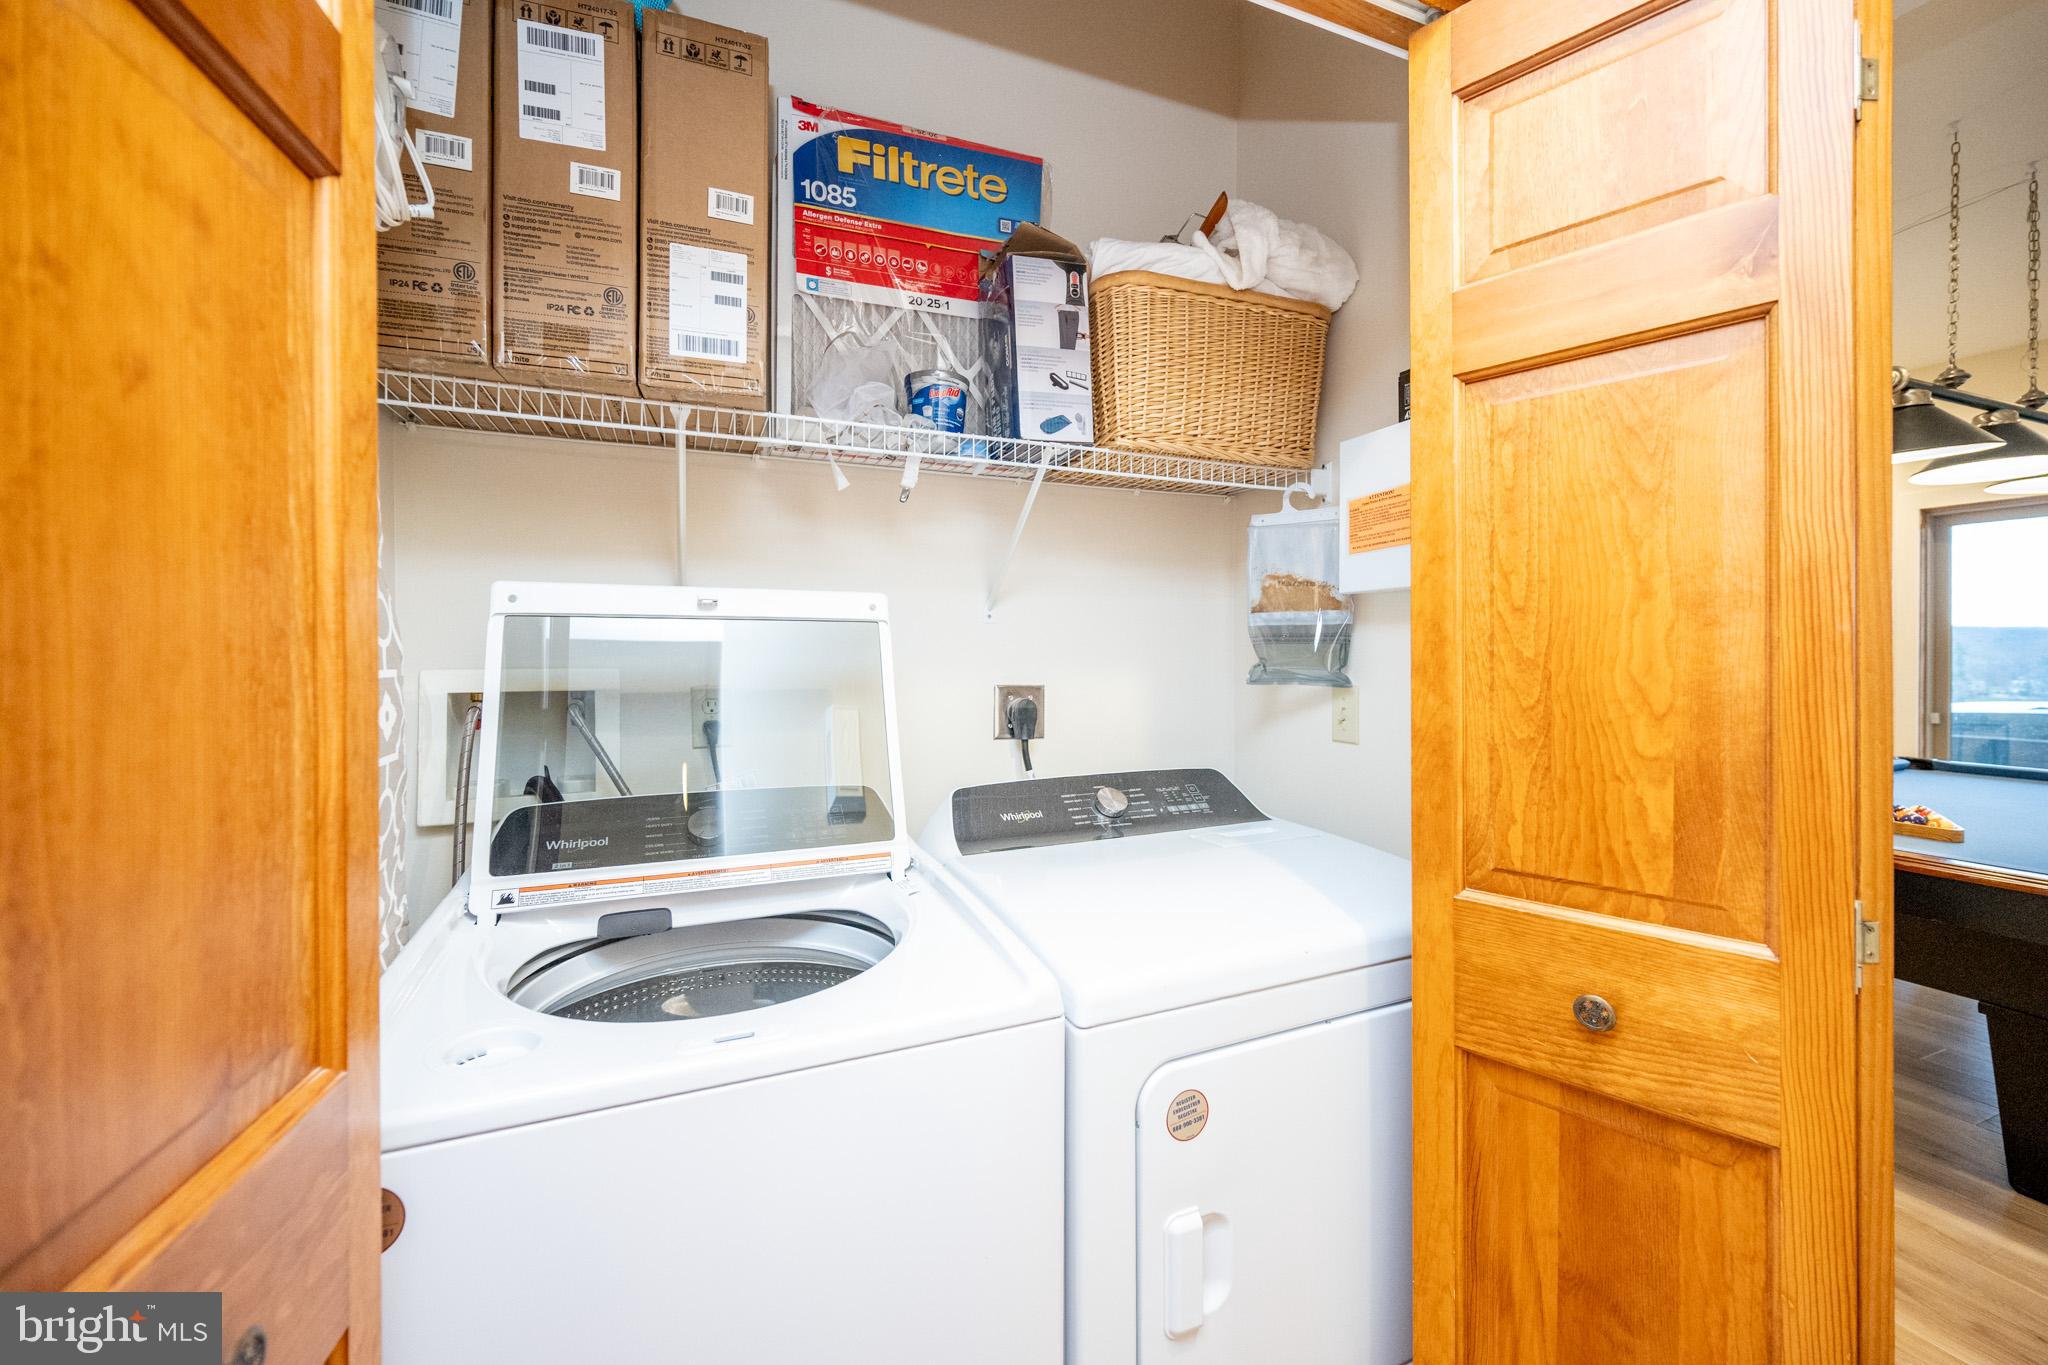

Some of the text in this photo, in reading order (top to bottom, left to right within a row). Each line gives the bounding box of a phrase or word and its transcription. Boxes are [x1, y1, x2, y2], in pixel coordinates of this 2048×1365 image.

[797, 119, 819, 133] 3M
[837, 135, 1009, 204] Filtrete
[800, 178, 857, 208] 1085
[802, 209, 833, 222] Allergen
[834, 215, 862, 226] Defense
[863, 222, 882, 230] Extra
[389, 279, 409, 288] IP24
[546, 303, 565, 312] IP24
[999, 809, 1044, 824] Whirlpool
[545, 836, 609, 850] Whirlpool
